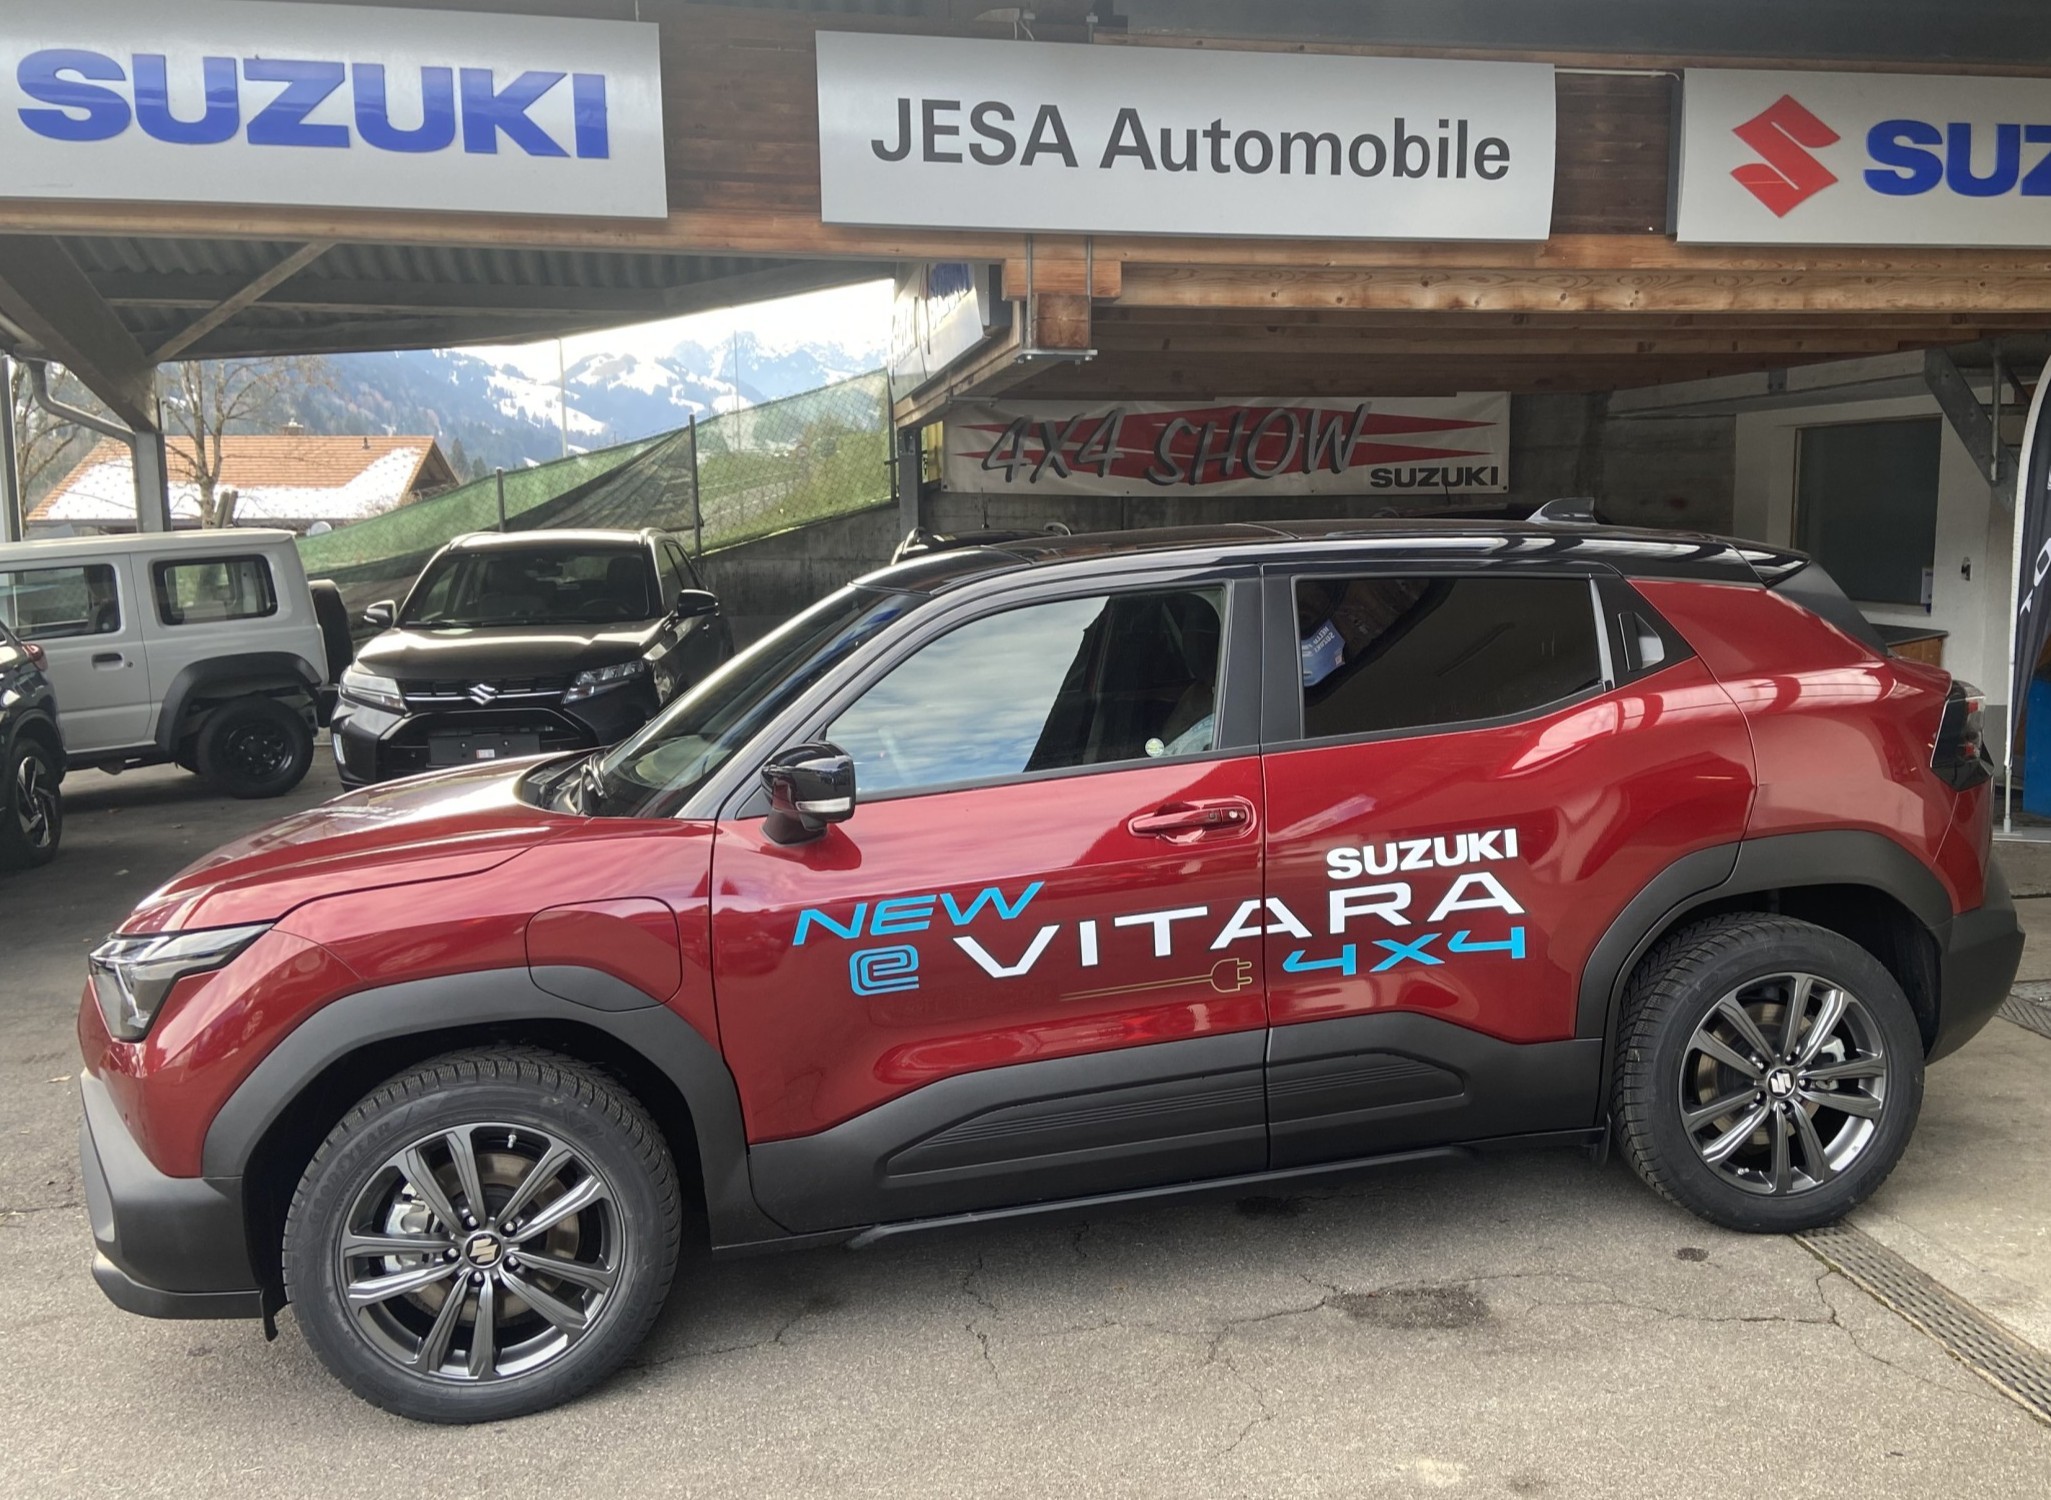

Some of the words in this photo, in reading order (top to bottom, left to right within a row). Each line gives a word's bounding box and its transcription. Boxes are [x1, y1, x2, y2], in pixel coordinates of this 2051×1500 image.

[15, 48, 610, 160] SUZUKI
[871, 97, 1079, 168] JESA
[1099, 107, 1511, 180] Automobile
[981, 406, 1126, 484] 4X4
[1143, 401, 1373, 486] SHOW
[1369, 465, 1500, 489] SUZUKI
[1327, 828, 1518, 880] SUZUKI
[792, 881, 1045, 947] NEW
[953, 871, 1525, 979] VITARA
